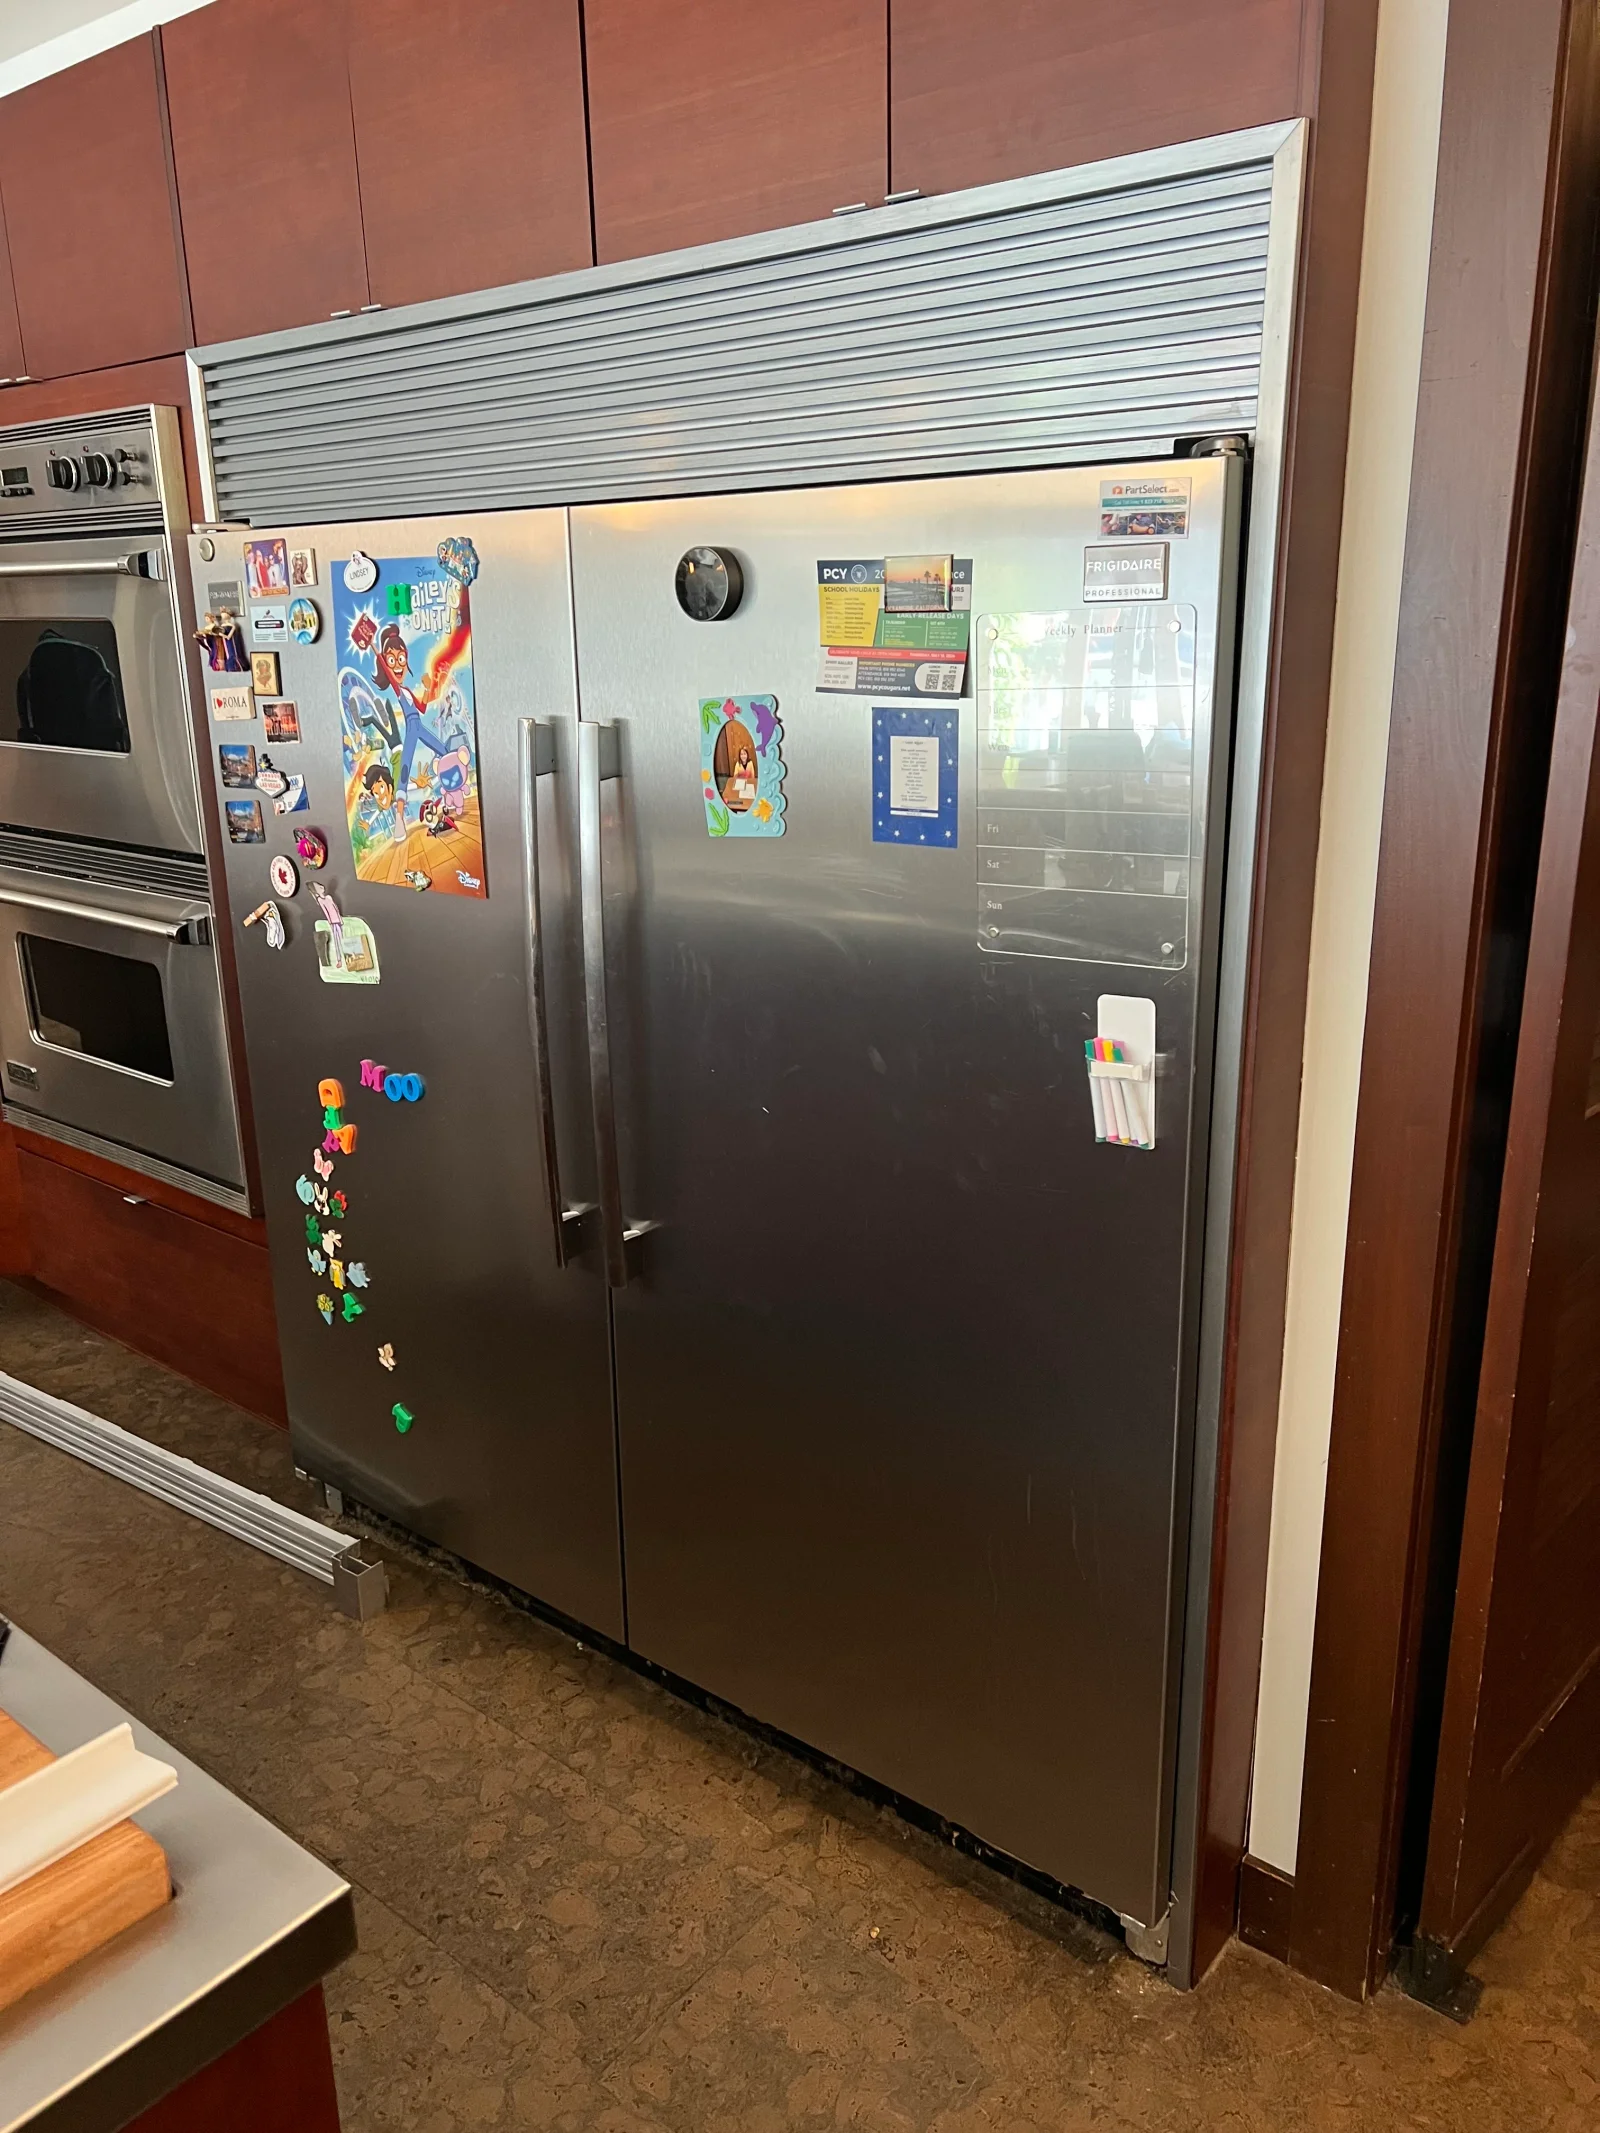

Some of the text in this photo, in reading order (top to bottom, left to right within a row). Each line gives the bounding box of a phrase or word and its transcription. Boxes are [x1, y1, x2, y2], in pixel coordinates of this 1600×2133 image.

[1085, 558, 1162, 573] FRIGIDAIRE
[823, 568, 847, 580] PCY
[1085, 587, 1161, 598] PROFESSIONAL
[1043, 623, 1123, 638] eekly Planner
[223, 696, 248, 709] ROMA
[986, 823, 999, 833] Fri
[986, 859, 1000, 869] Sat
[986, 900, 1003, 910] Sun
[359, 1059, 424, 1102] MOO
